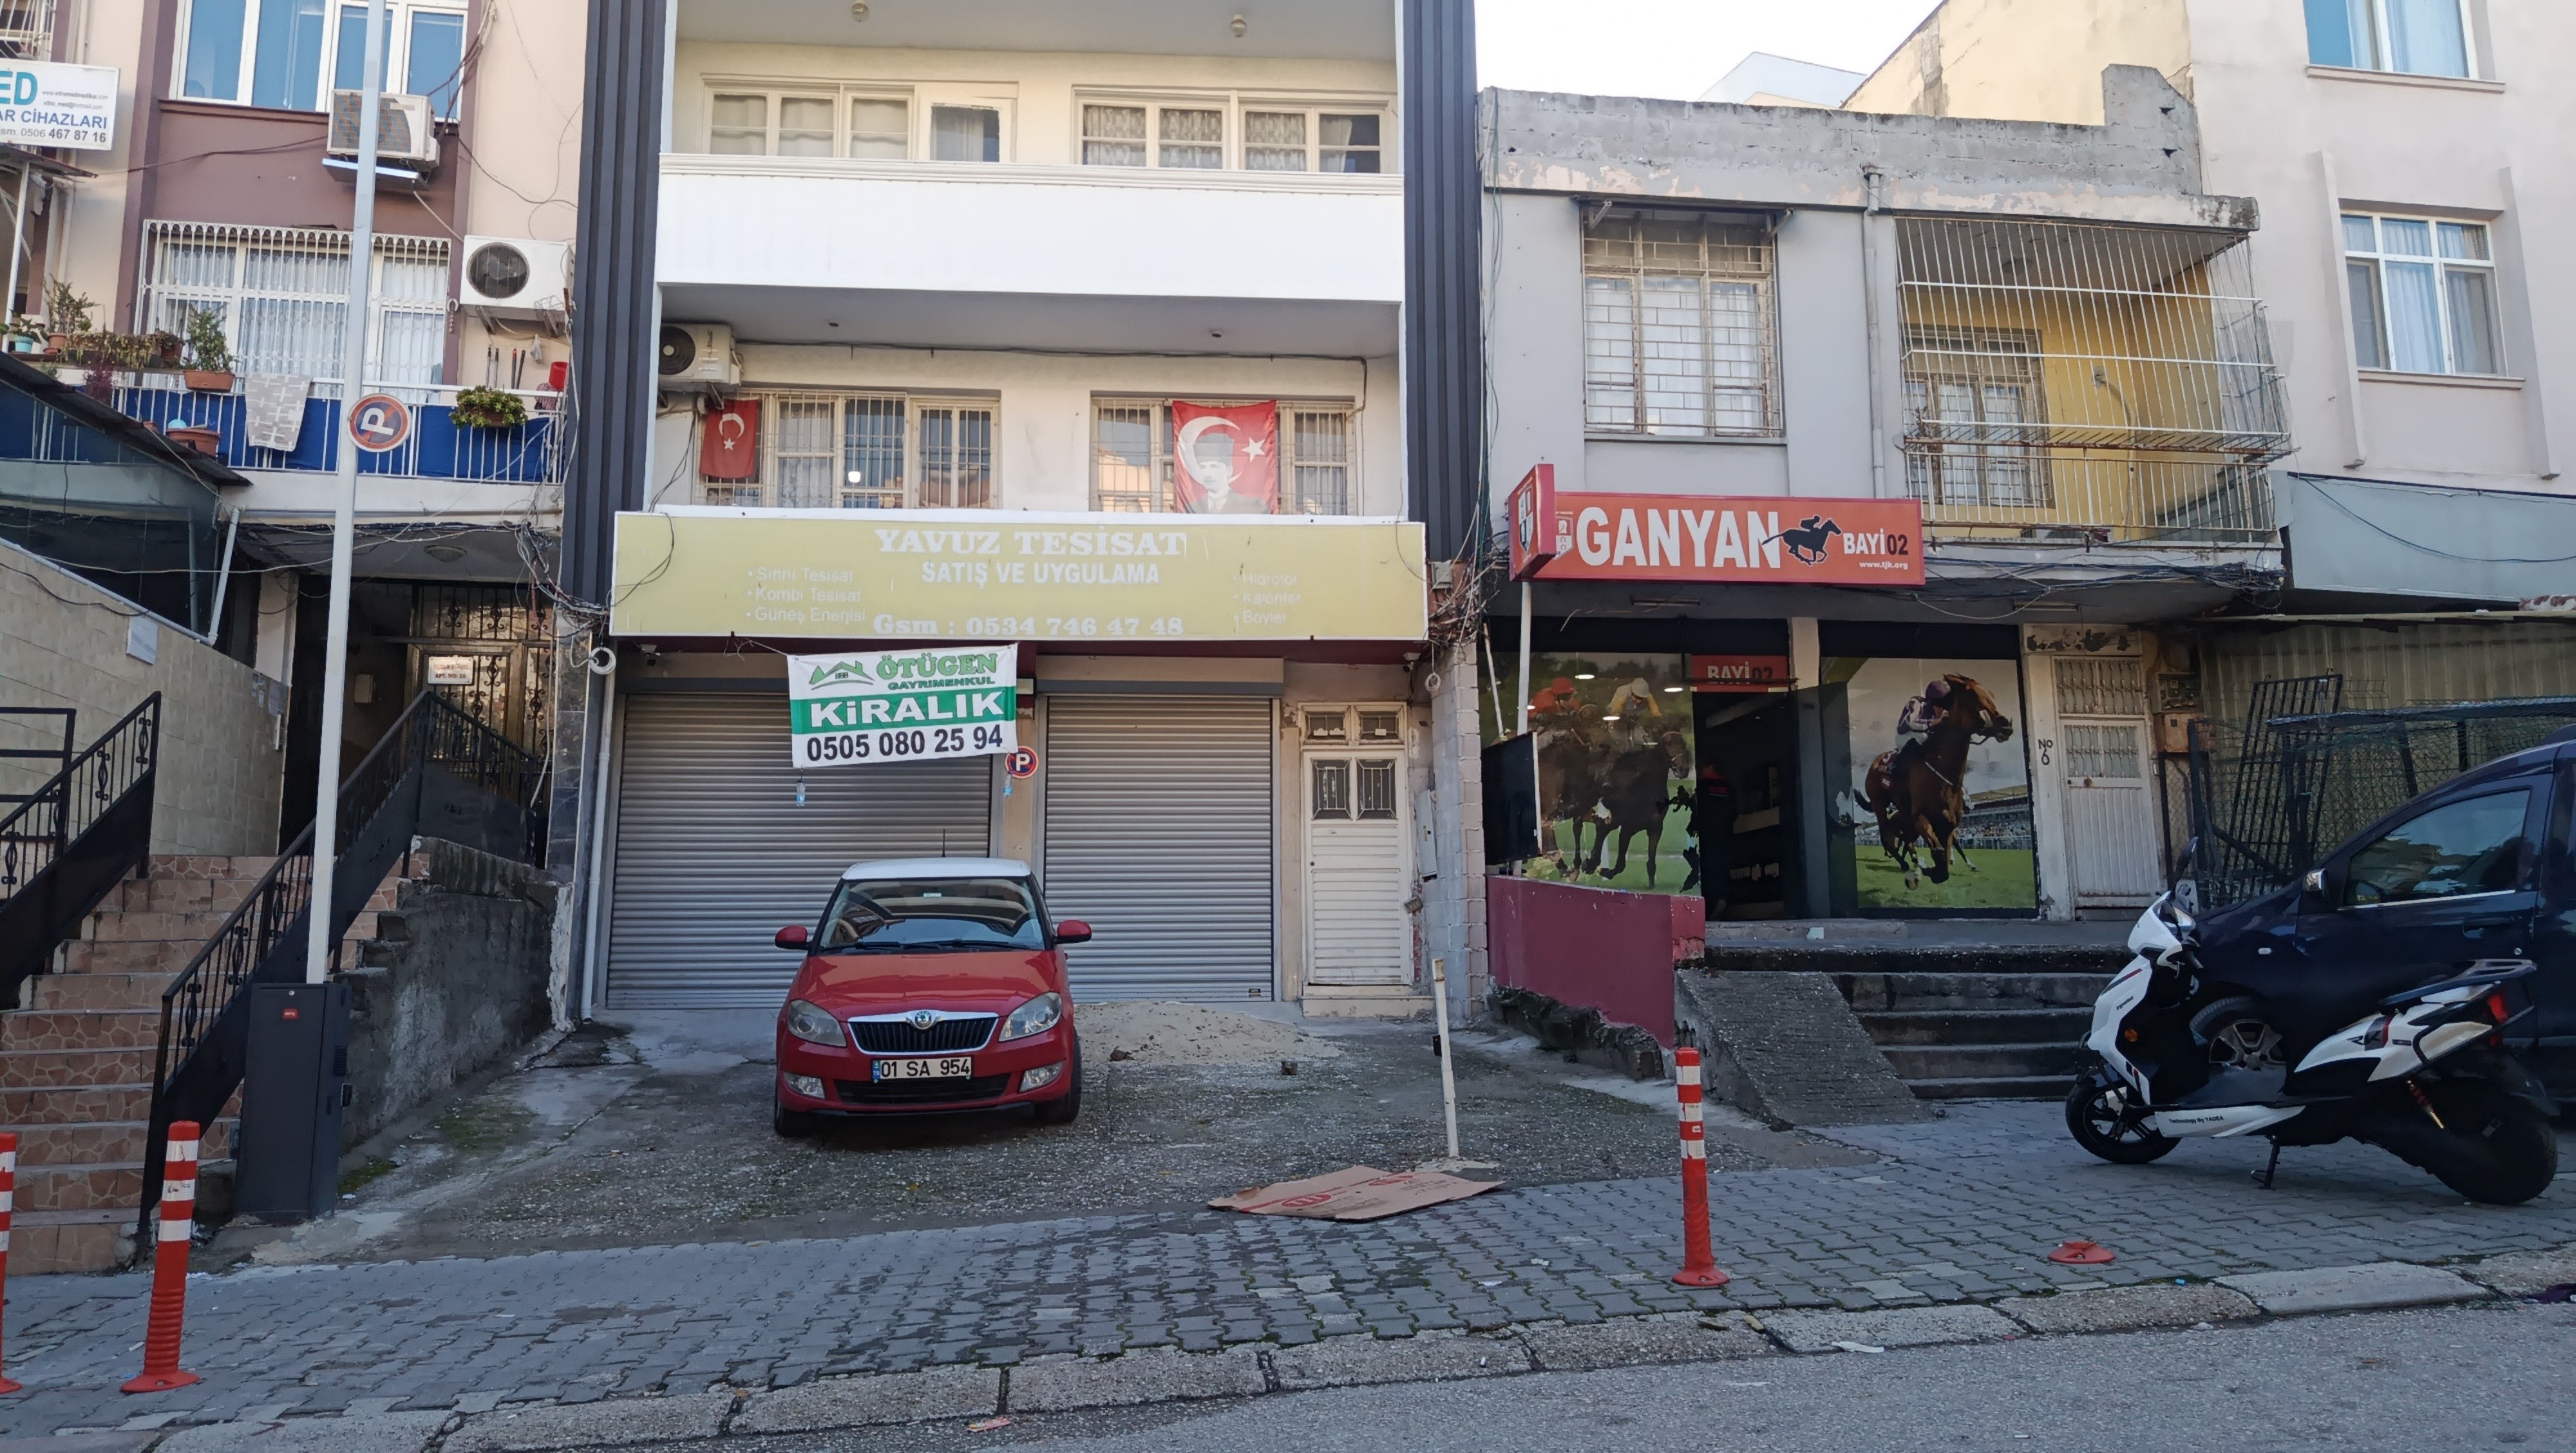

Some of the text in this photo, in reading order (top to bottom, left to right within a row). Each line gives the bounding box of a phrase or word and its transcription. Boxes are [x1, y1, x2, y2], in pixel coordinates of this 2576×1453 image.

[21, 108, 107, 129] CİHAZLARI
[21, 128, 46, 137] 0506
[48, 128, 70, 139] 467
[74, 130, 88, 141] 87
[92, 131, 106, 143] 16
[361, 407, 394, 436] P
[874, 525, 1187, 556] YAVUZ TESİSAT
[1577, 506, 1781, 568] GANYAN
[922, 561, 1160, 589] SATIŞ VE UYGULAMA
[1859, 561, 1908, 570] www.tjk.org
[755, 587, 804, 602] Kombi
[755, 606, 805, 624] Güneş
[873, 614, 938, 634] Gsm
[966, 616, 1036, 636] 0534
[1046, 617, 1097, 636] 746
[1107, 617, 1141, 636] 47
[1150, 616, 1184, 636] 48
[876, 652, 998, 680] ÖTÜGEN
[807, 724, 1003, 762] 0505 080 25 94
[1016, 754, 1030, 771] P
[881, 1061, 897, 1078] 01
[906, 1061, 931, 1076] SA
[940, 1059, 971, 1076] 954
